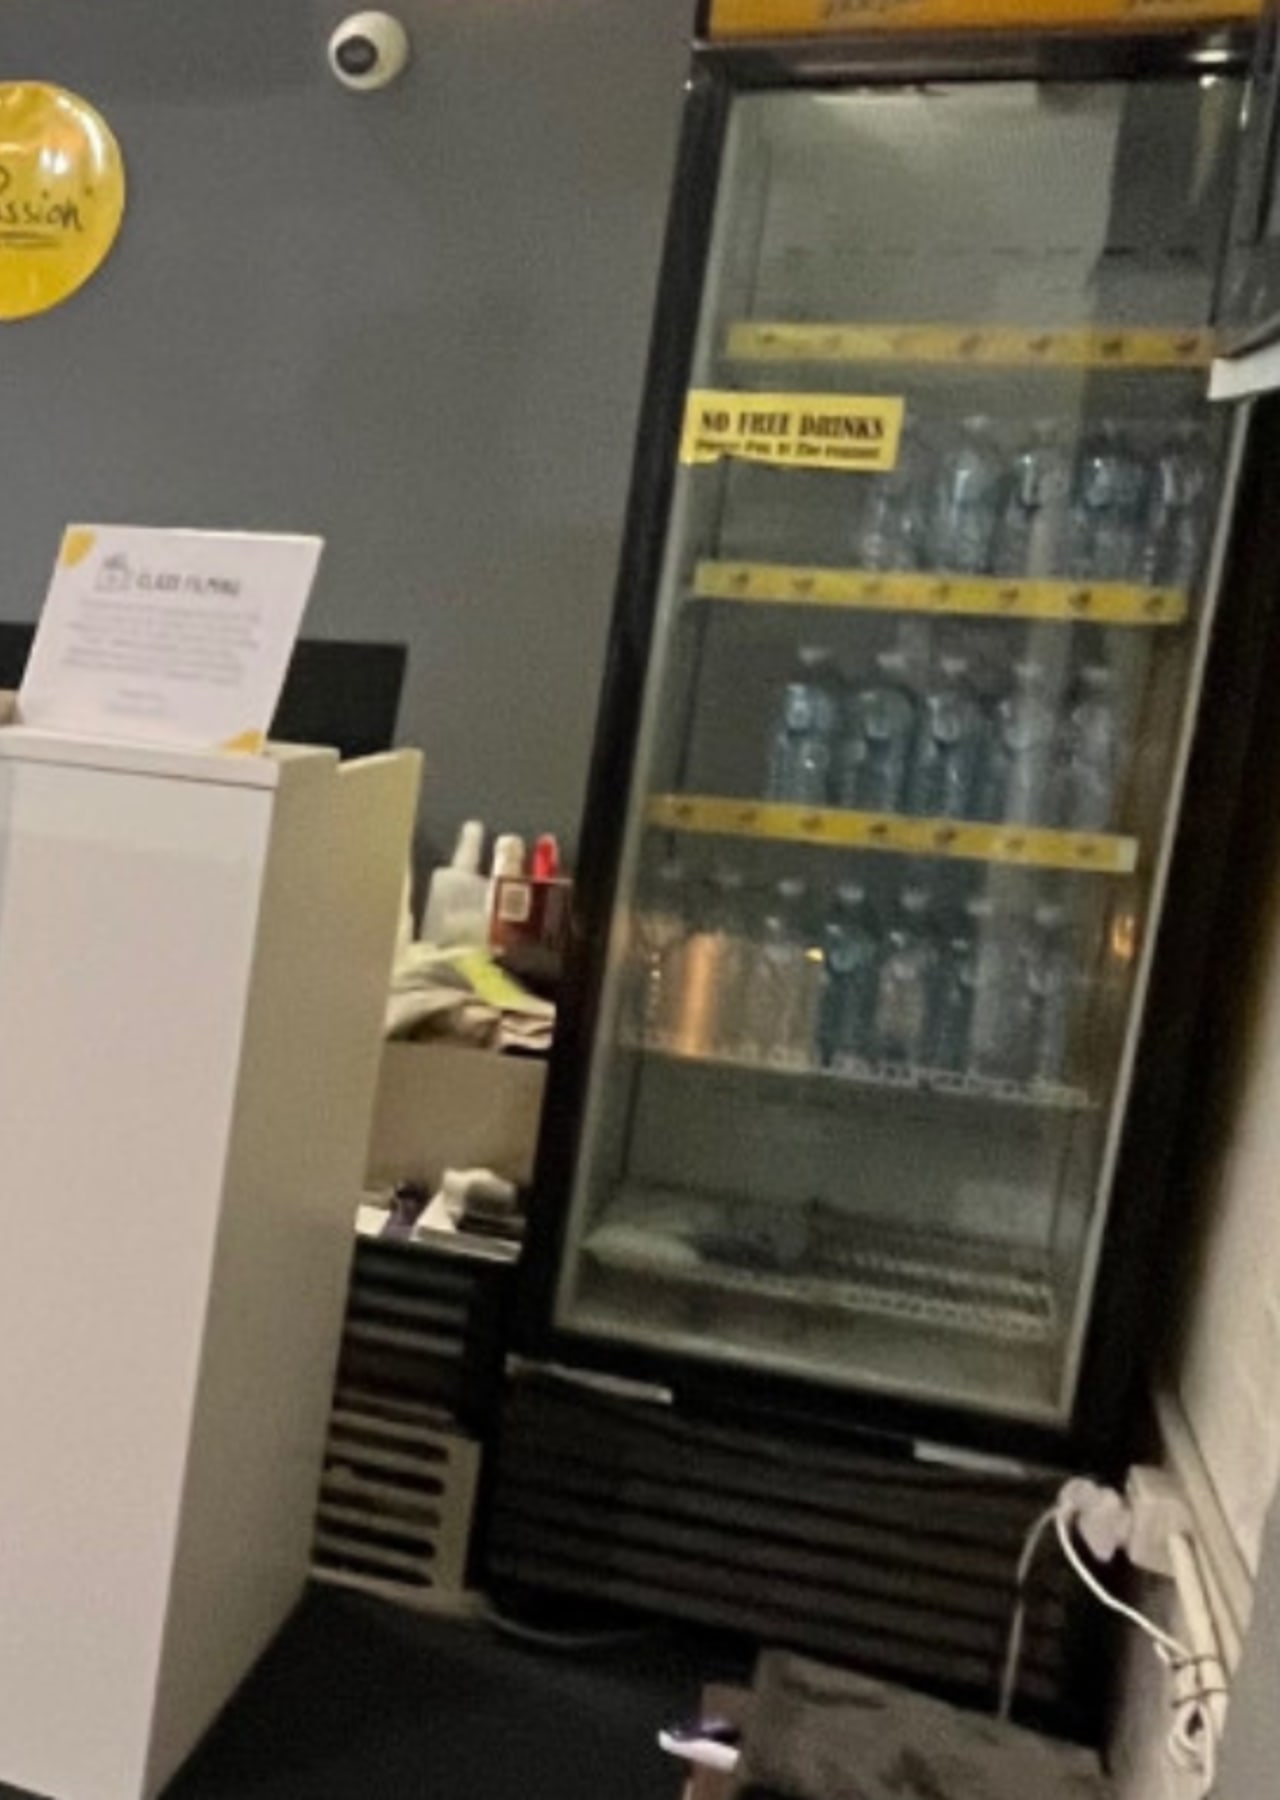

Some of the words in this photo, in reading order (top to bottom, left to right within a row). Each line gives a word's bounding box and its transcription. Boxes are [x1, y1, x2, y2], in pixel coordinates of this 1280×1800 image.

[701, 411, 731, 433] NO
[738, 411, 790, 435] FREE
[798, 413, 884, 440] DRINKS
